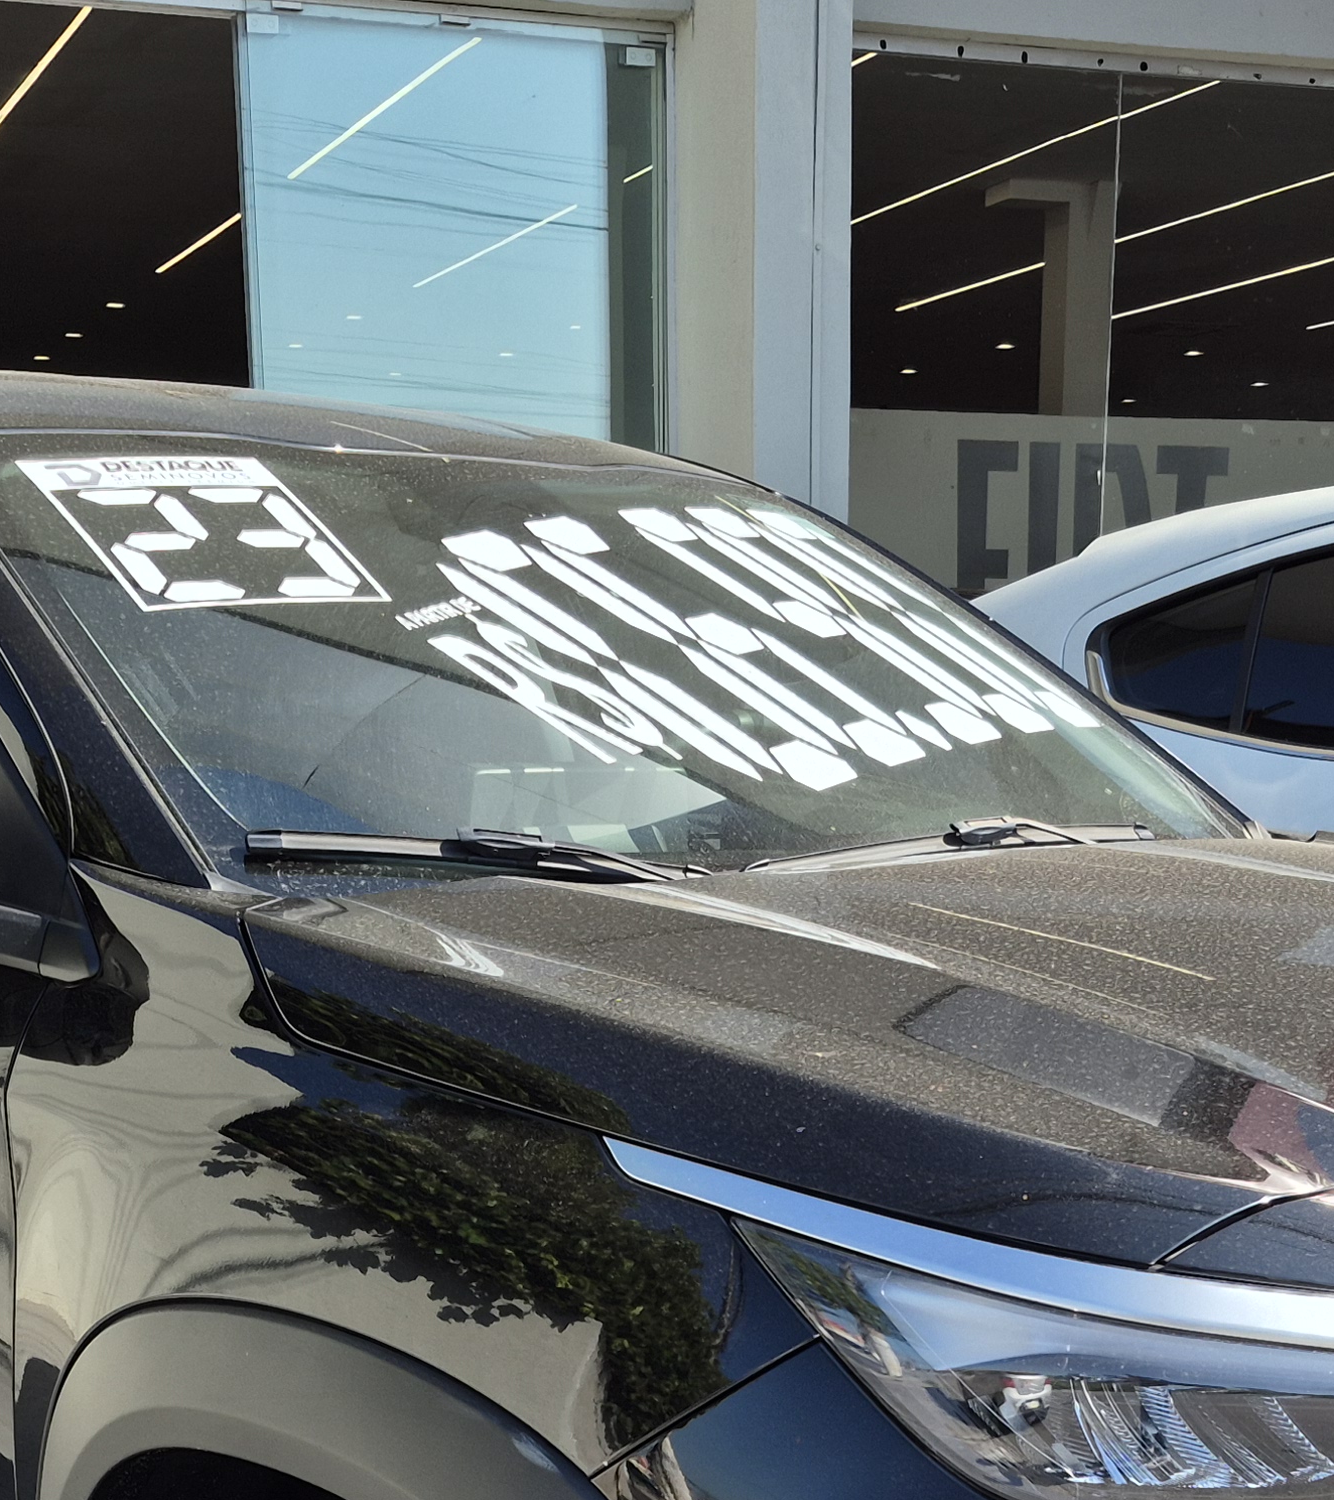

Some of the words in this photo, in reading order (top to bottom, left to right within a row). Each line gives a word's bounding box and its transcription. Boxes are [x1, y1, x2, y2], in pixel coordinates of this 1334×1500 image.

[100, 460, 245, 473] DESTAQUE
[110, 472, 253, 482] SEMINOVOS
[956, 438, 1230, 590] FIAT
[76, 486, 362, 603] 23
[427, 613, 683, 765] R$
